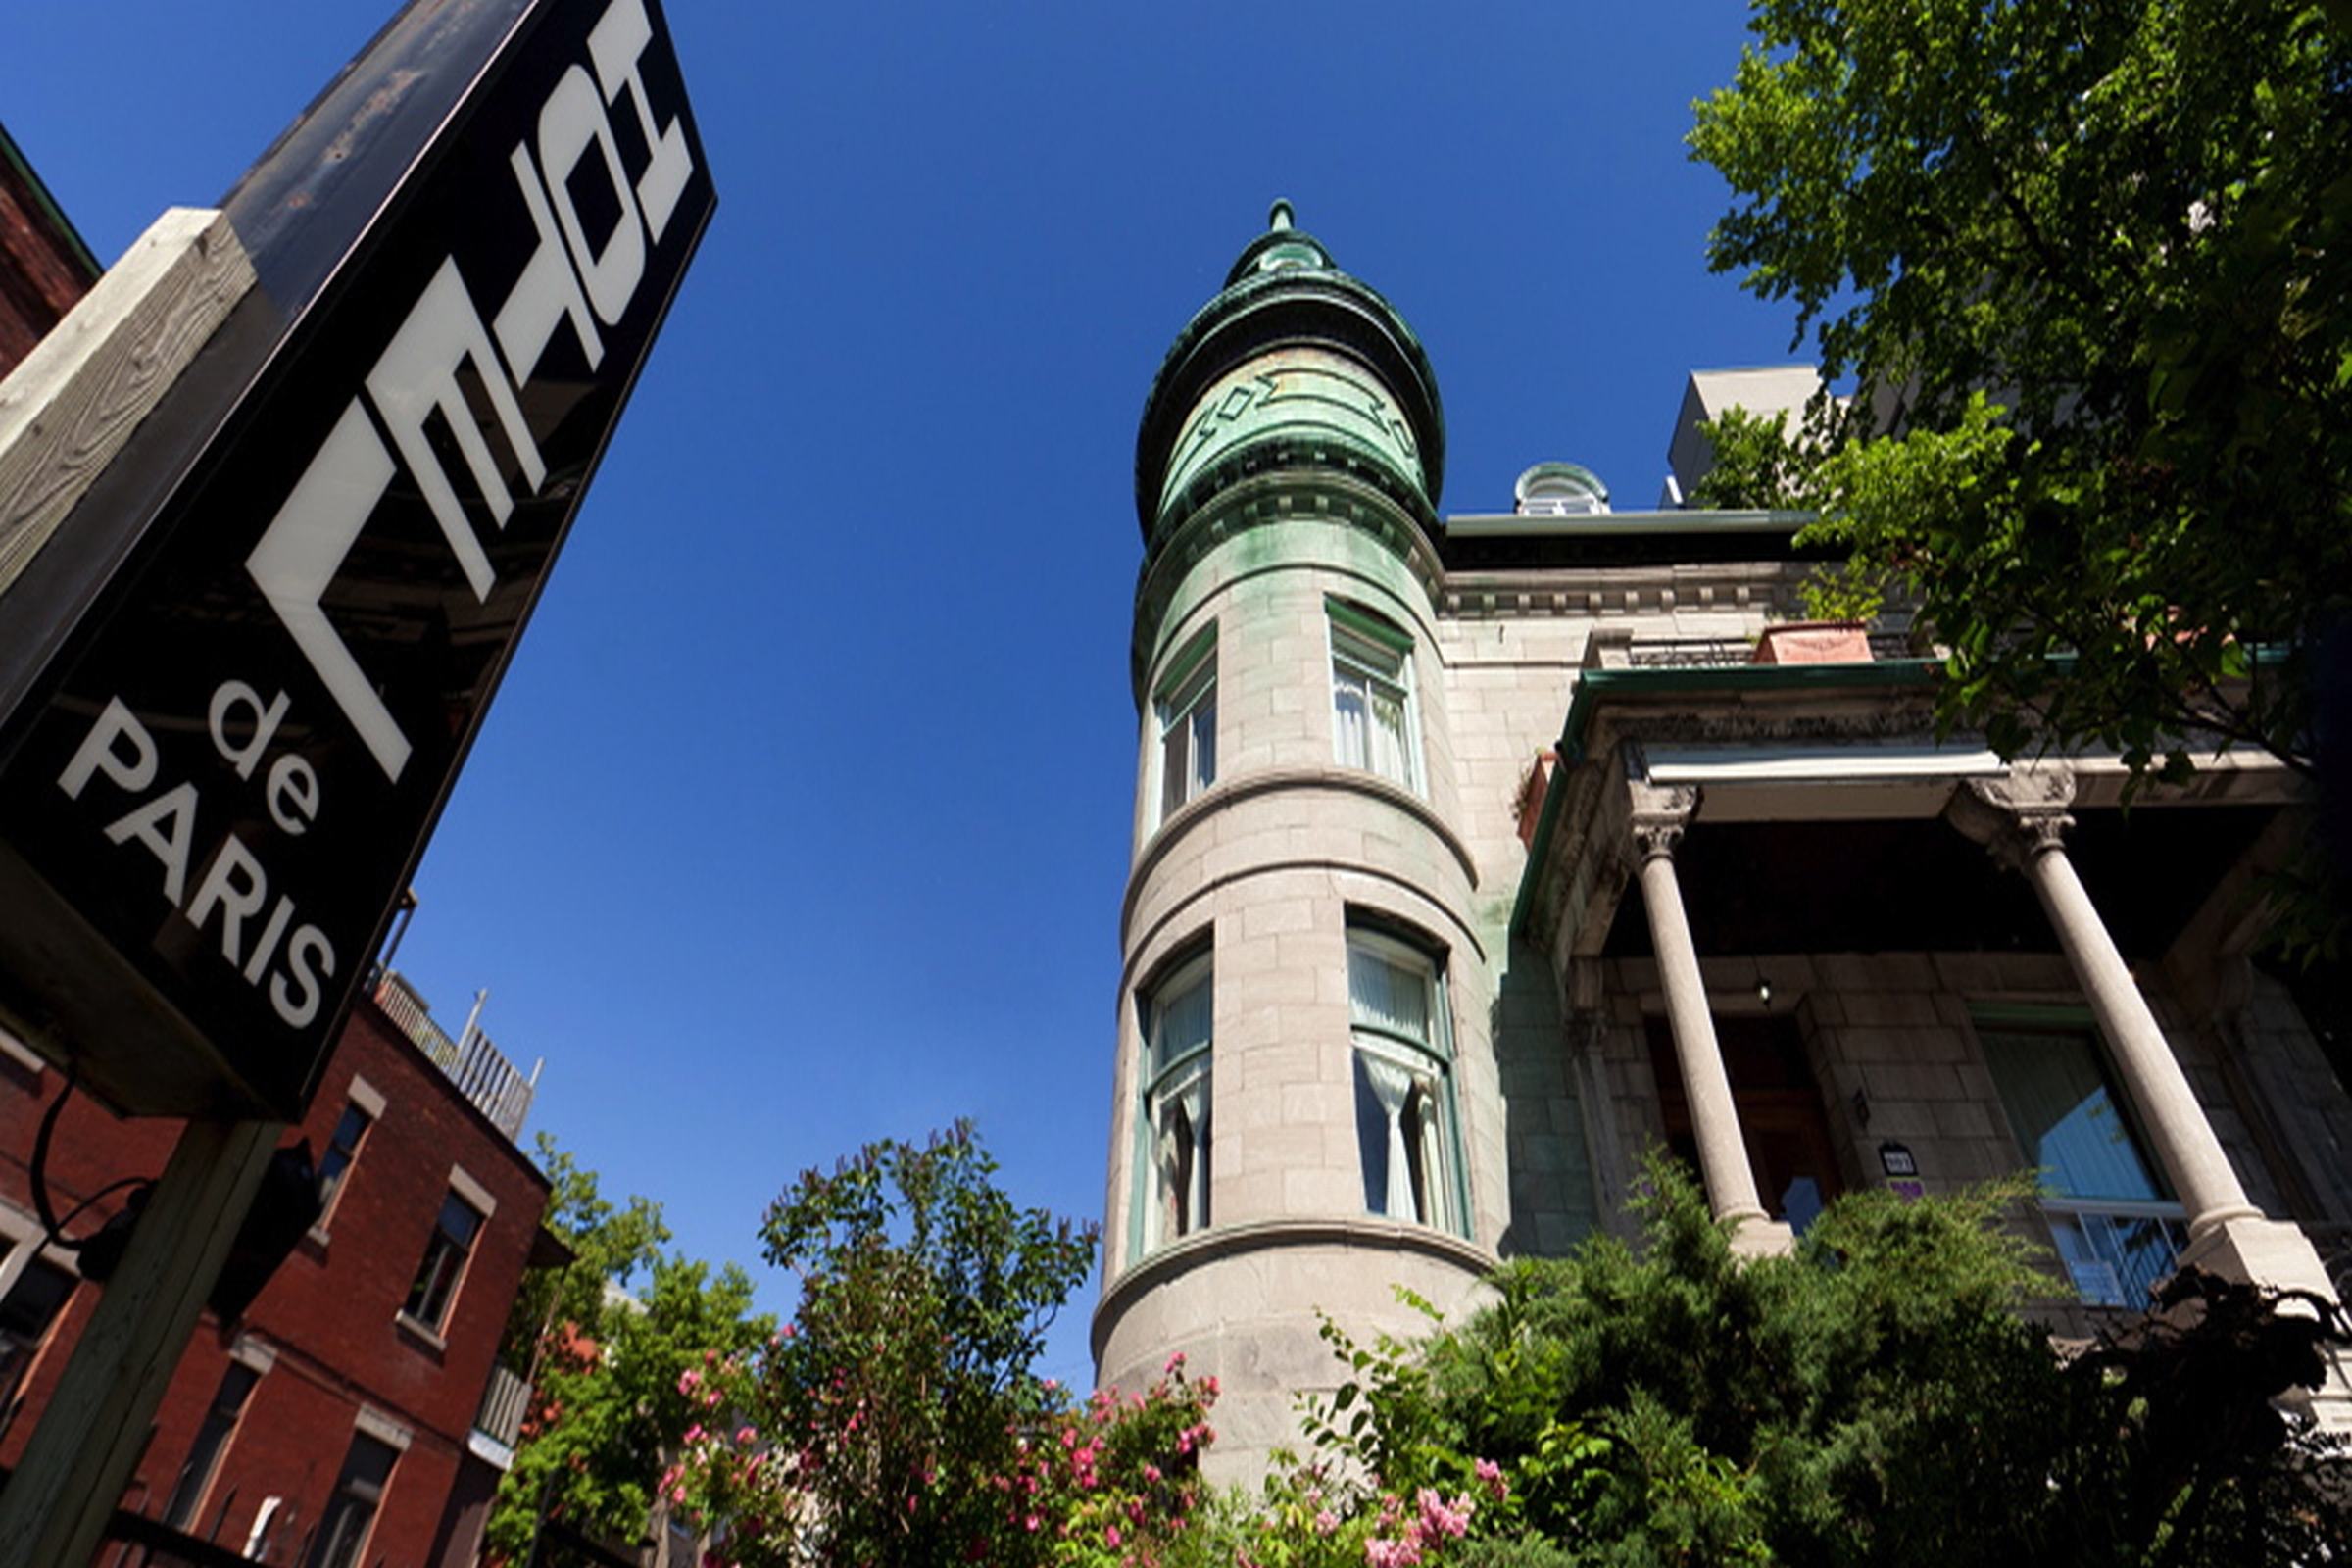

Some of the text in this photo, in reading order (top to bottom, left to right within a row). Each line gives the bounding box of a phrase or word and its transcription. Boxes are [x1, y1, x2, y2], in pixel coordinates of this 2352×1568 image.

[244, 0, 694, 784] HOTEL
[57, 694, 335, 1029] PARIS
[209, 679, 319, 835] de
